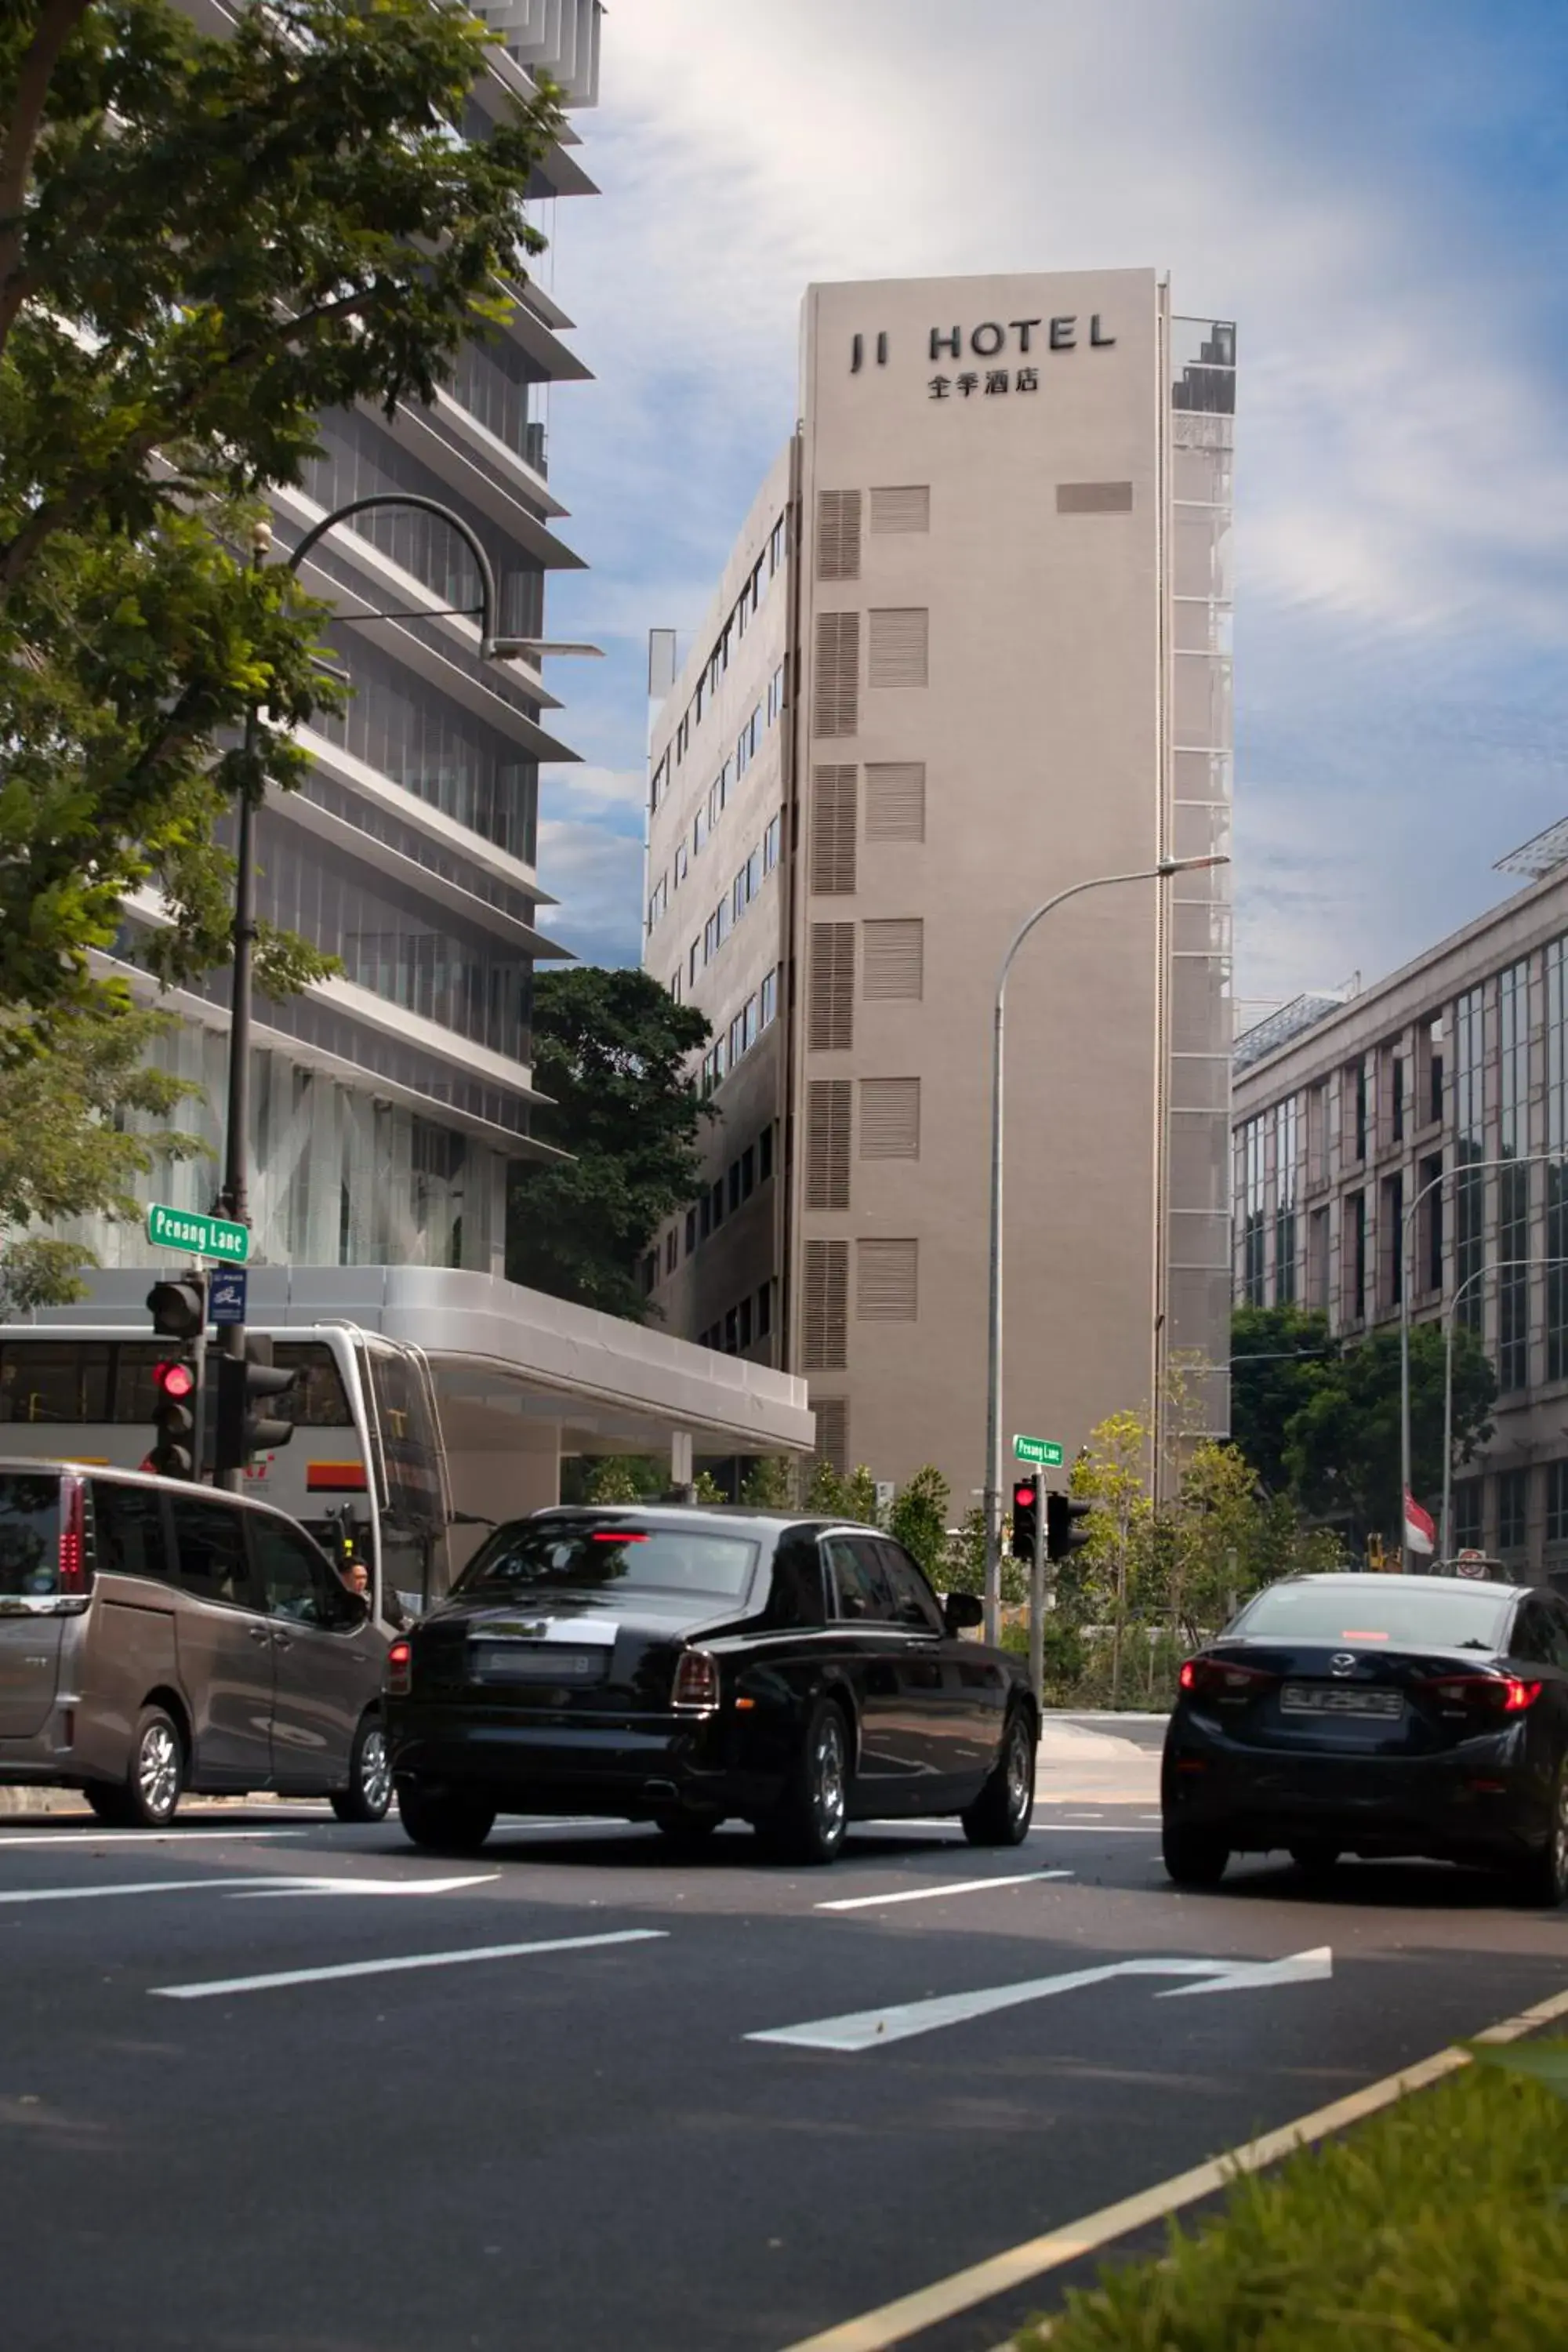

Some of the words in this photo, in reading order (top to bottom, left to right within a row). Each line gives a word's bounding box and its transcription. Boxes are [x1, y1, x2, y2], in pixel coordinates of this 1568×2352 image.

[850, 331, 887, 374] JI
[928, 314, 1116, 361] HOTEL
[928, 366, 1040, 399] 全季酒店
[157, 1210, 206, 1250] Penang
[210, 1223, 242, 1252] Lane
